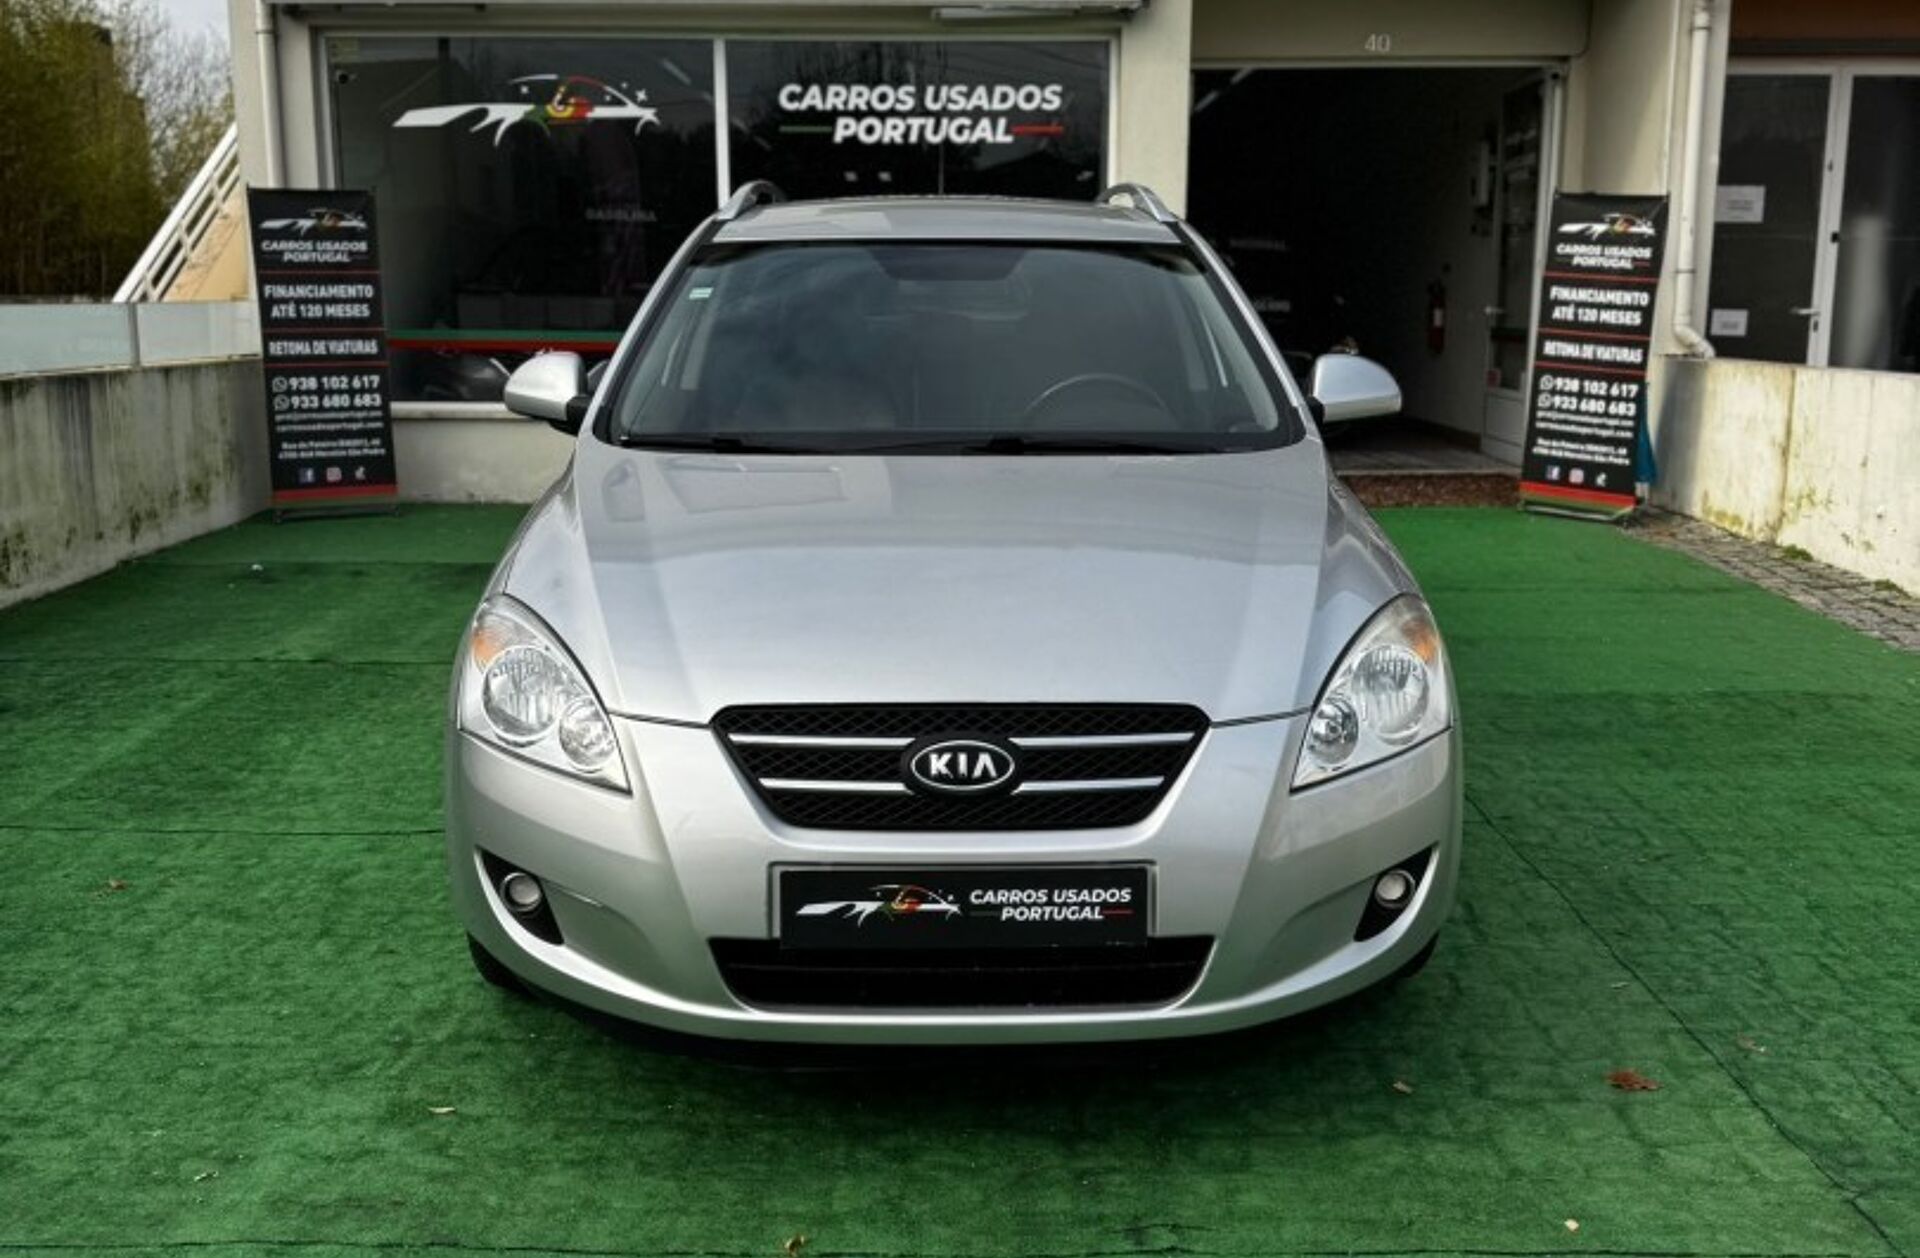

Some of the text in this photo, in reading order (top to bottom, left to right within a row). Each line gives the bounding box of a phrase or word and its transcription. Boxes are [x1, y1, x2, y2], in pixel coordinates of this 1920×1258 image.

[1365, 33, 1390, 53] 40
[778, 84, 1062, 111] CARROS USADOS
[833, 117, 1015, 144] PORTUGAL
[261, 240, 368, 252] CARROS USADOS
[1556, 244, 1652, 258] CARROS USADOS
[283, 251, 350, 262] PORTUGAL
[1572, 256, 1633, 269] PORTUGAL
[264, 284, 374, 298] FINANCIAMENTO
[1550, 285, 1650, 306] FINANCIAMENTO
[271, 302, 370, 318] ATÉ 120 MESES
[1552, 304, 1642, 325] ATÉ 120 MESES
[269, 339, 378, 354] RETOMA DE VIATURAS
[289, 375, 380, 390] 938 102 617
[1555, 378, 1639, 397] 938 102 617
[291, 393, 381, 409] 933 680 683
[1553, 396, 1636, 416] 933 680 683
[929, 752, 997, 778] KIA
[970, 888, 1132, 904] CARROS USADOS
[1000, 905, 1105, 921] PORTUGAL
